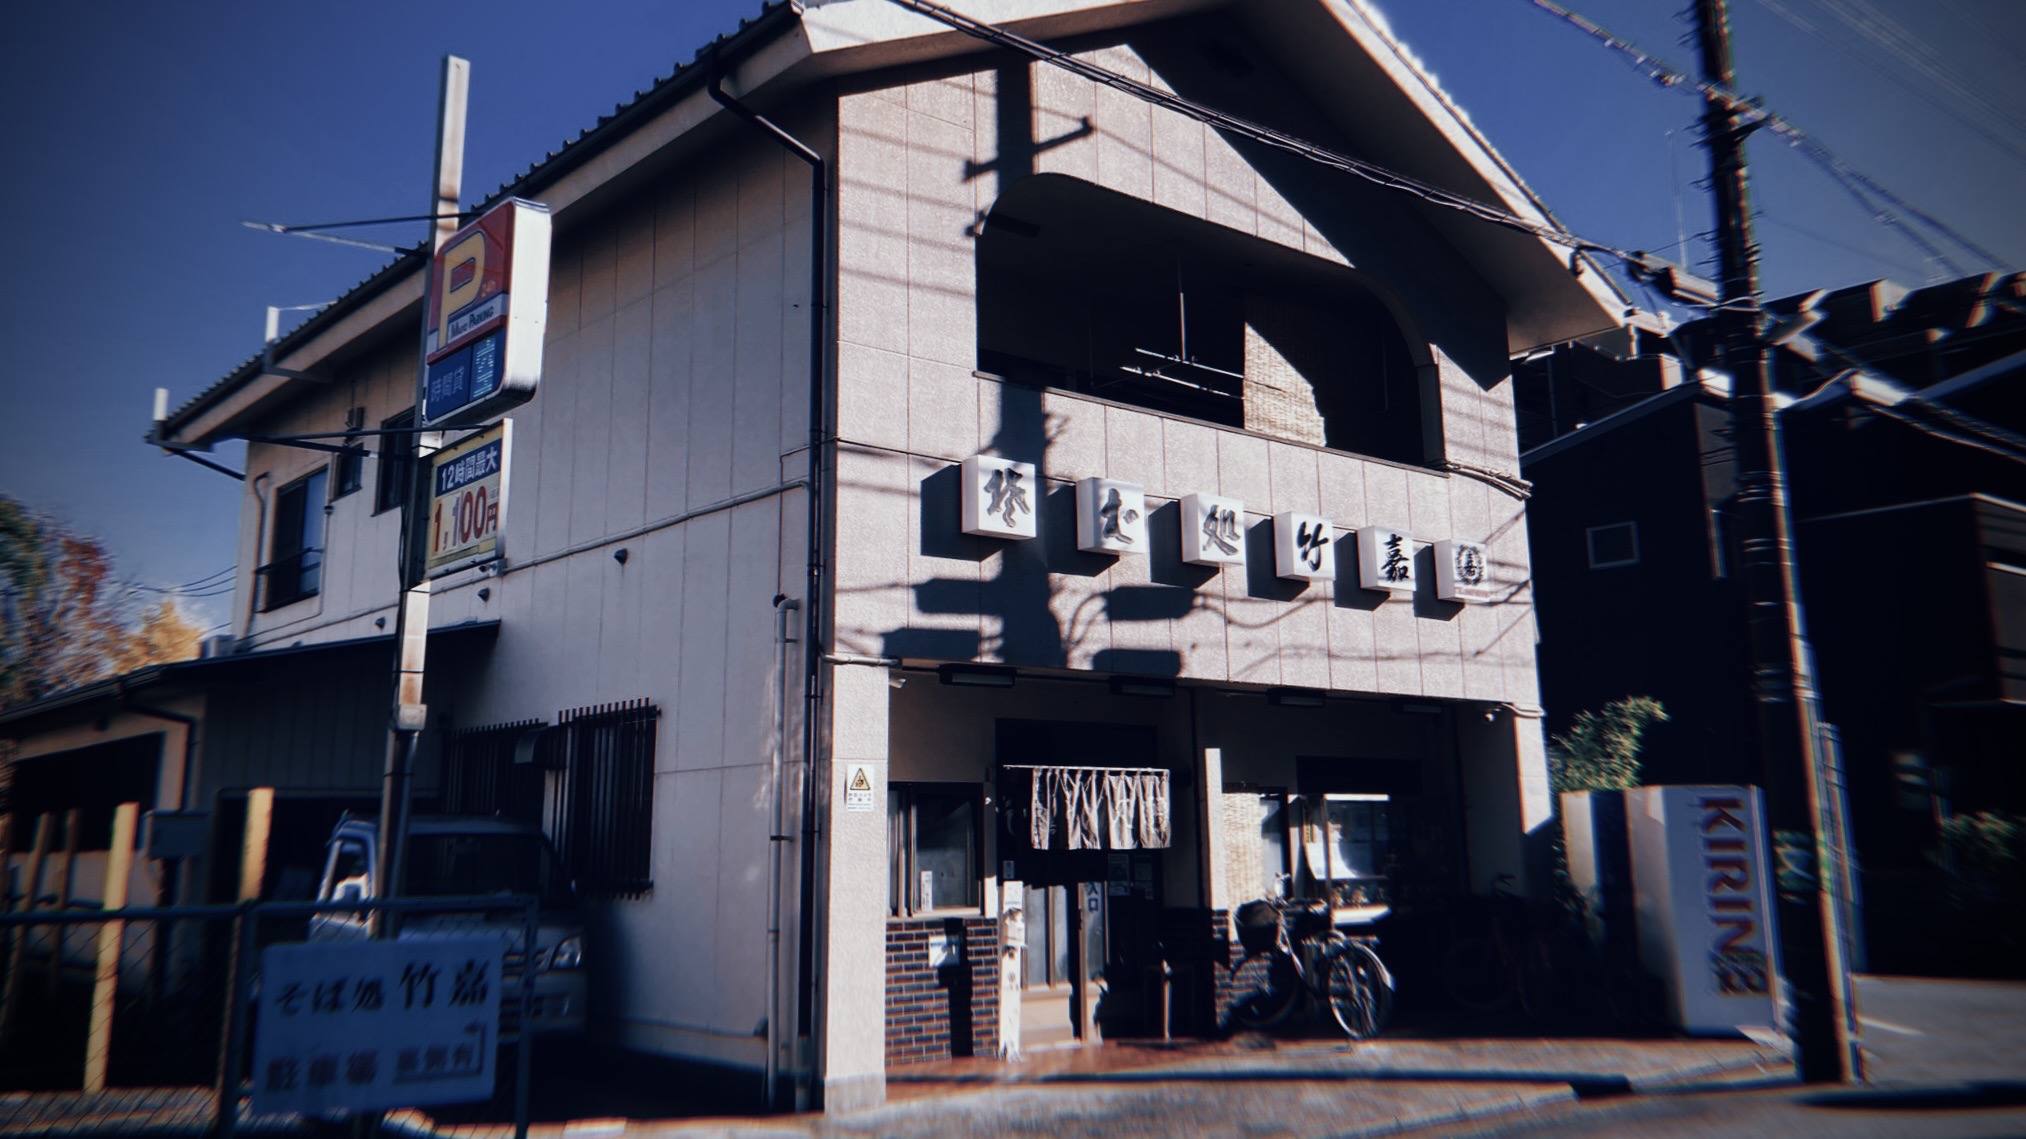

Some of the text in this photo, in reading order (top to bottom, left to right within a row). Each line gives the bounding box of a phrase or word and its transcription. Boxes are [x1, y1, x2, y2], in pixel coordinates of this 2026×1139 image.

[437, 231, 486, 351] P
[441, 446, 498, 492] 12時間最大
[434, 486, 499, 553] 1,100円
[1698, 797, 1757, 953] KIRIN
